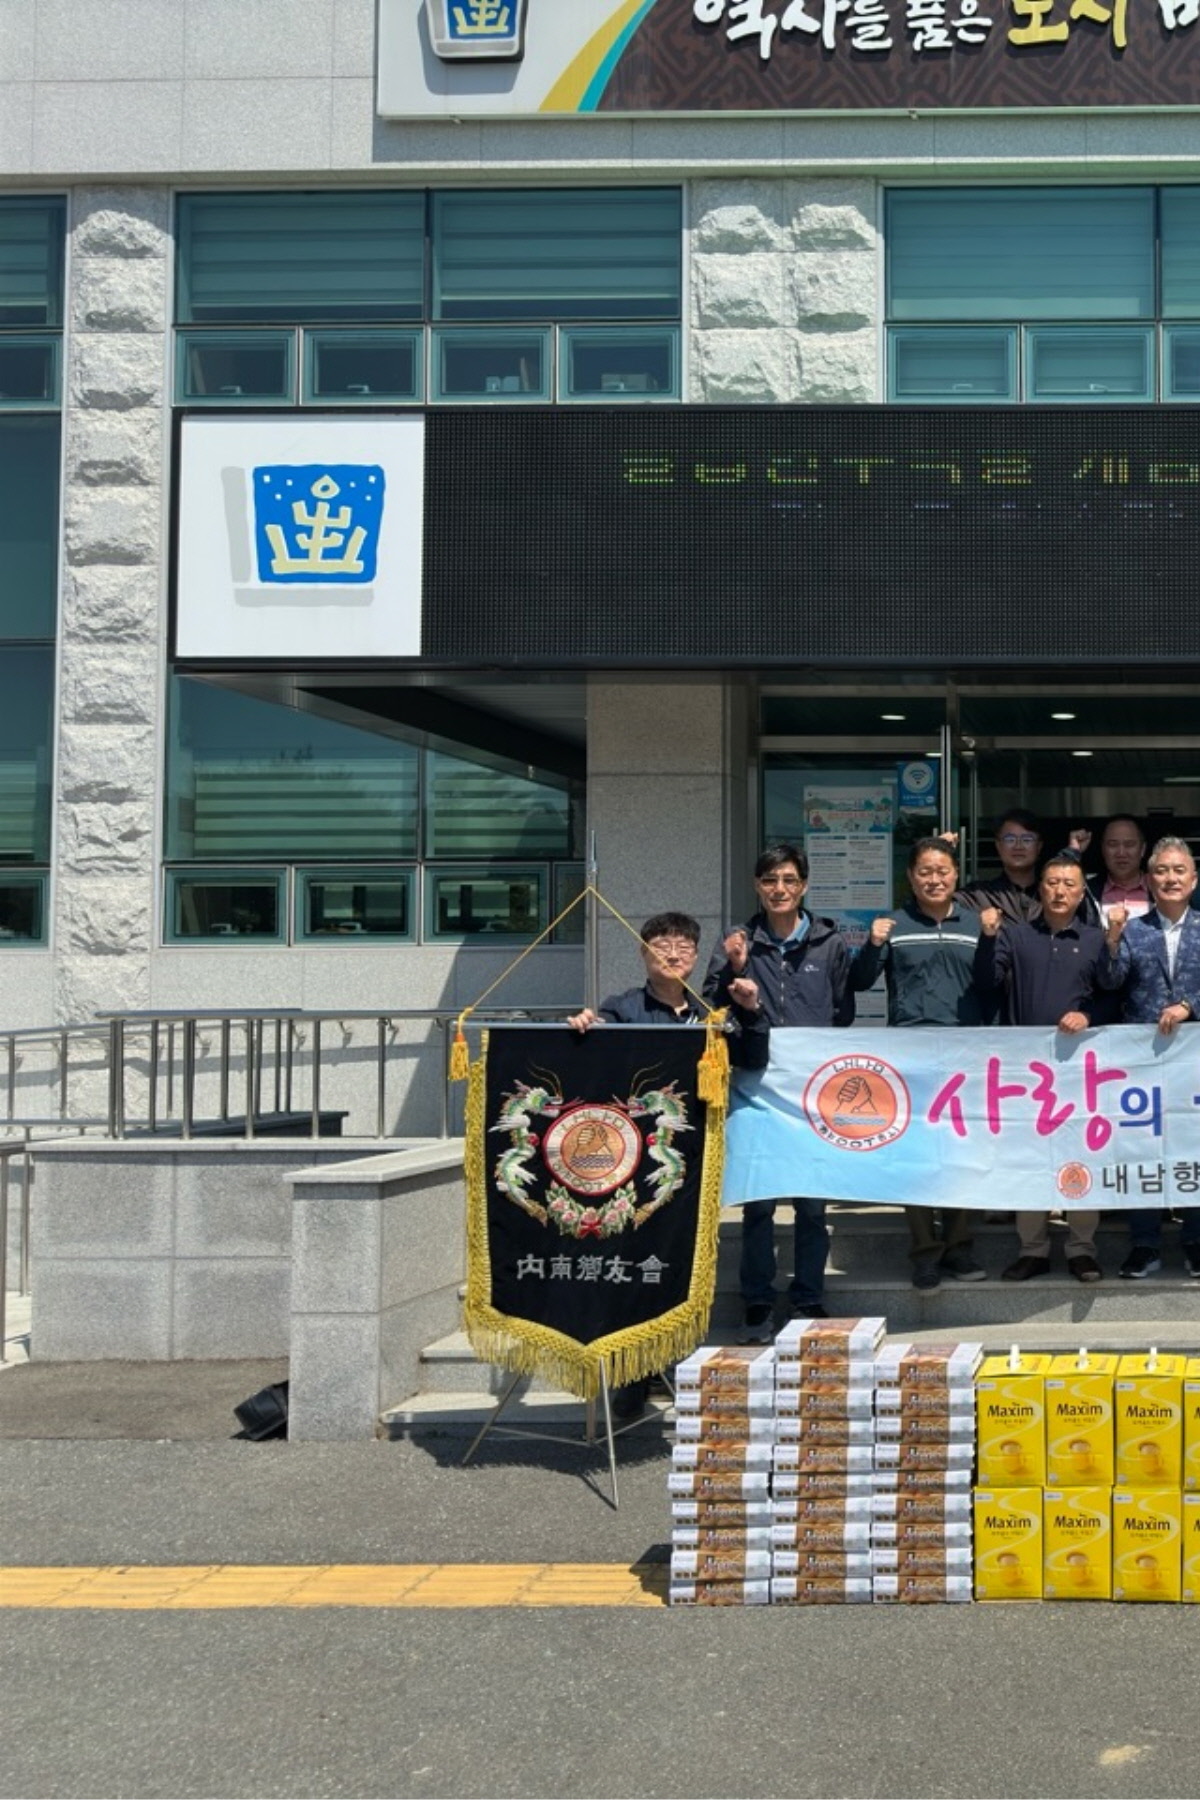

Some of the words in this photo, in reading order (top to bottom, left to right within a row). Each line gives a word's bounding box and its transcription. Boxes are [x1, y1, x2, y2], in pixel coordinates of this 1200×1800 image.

[928, 1050, 1161, 1151] 사랑의
[987, 1402, 1034, 1417] Maxim
[1056, 1402, 1103, 1416] Maxim
[1126, 1402, 1173, 1418] Maxim
[985, 1513, 1032, 1529] Maxim
[1055, 1512, 1101, 1528] Maxim
[1124, 1515, 1171, 1531] Maxim
